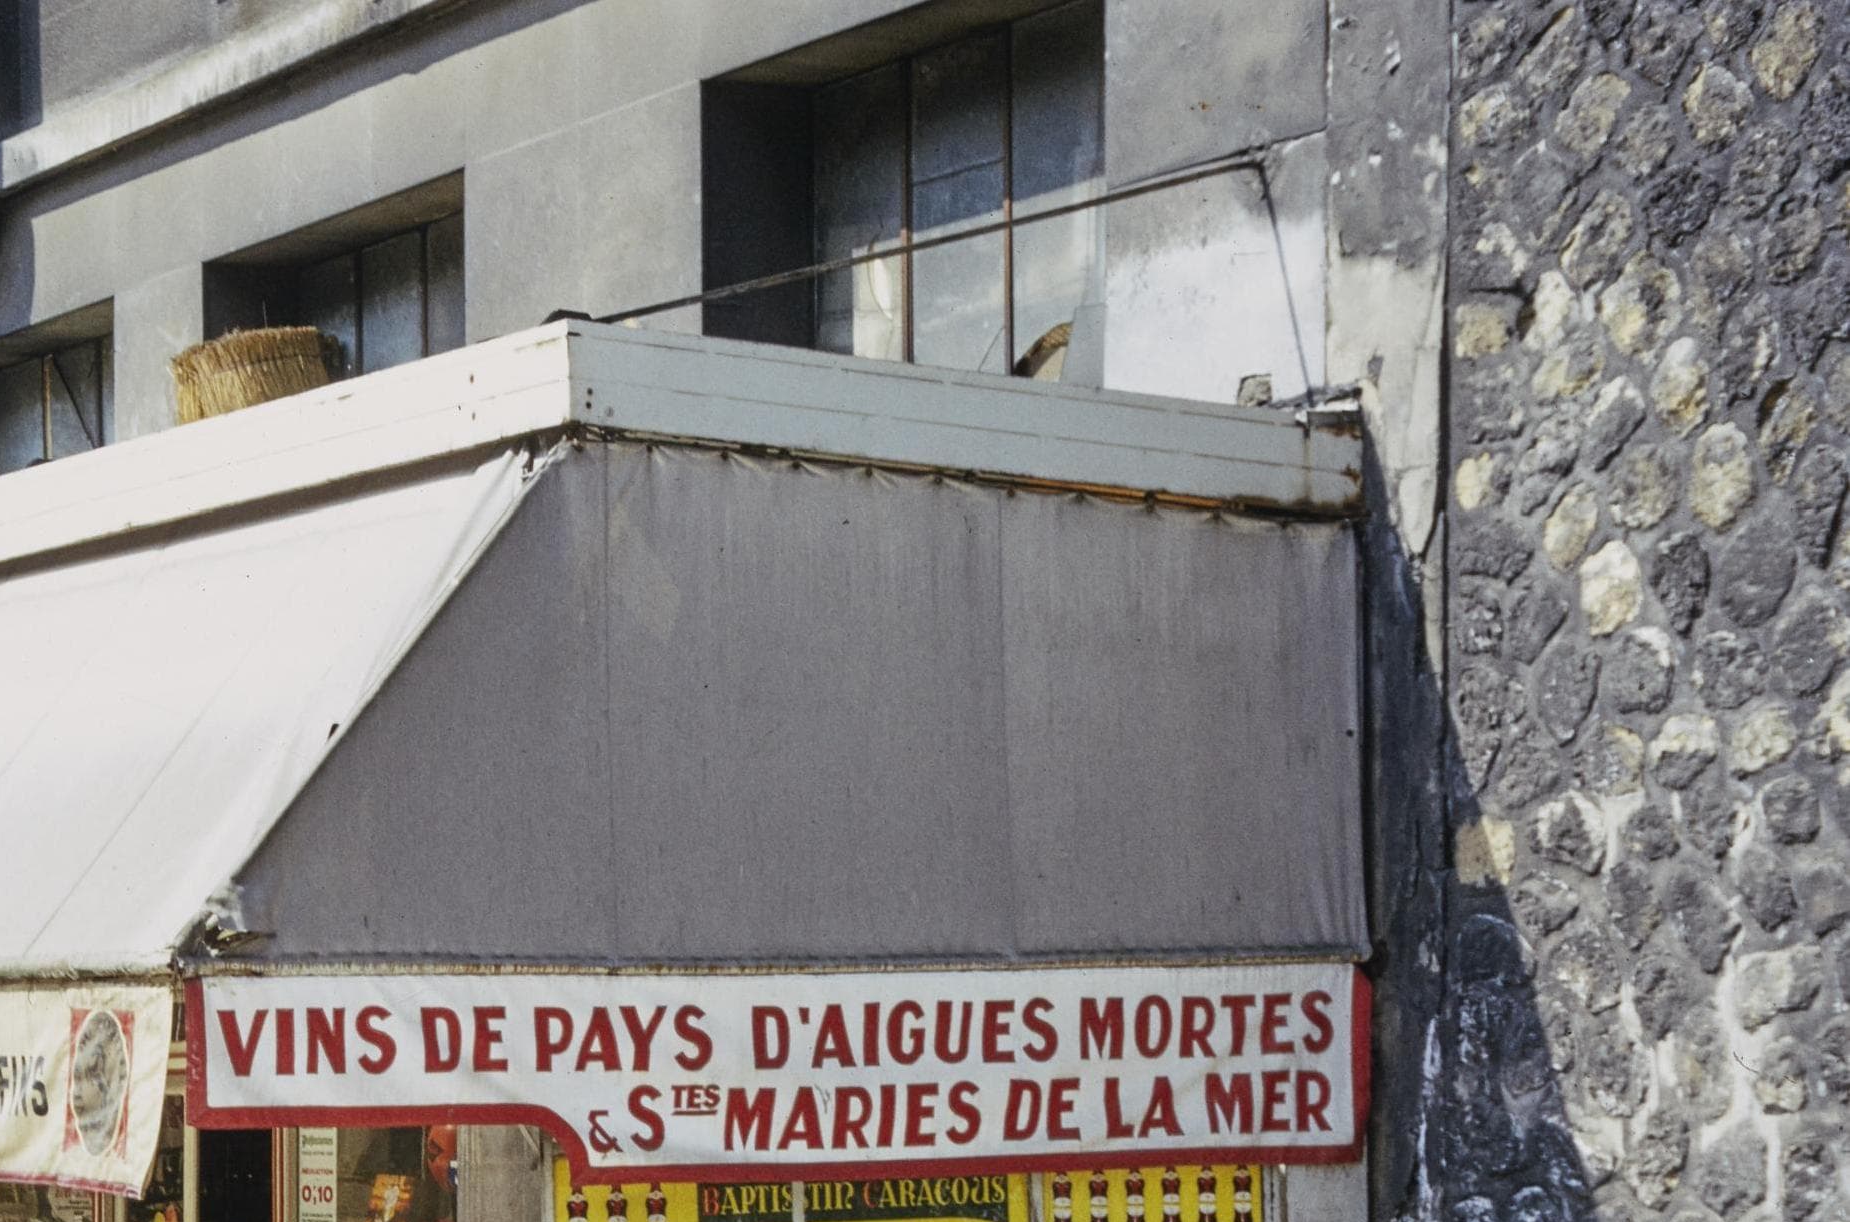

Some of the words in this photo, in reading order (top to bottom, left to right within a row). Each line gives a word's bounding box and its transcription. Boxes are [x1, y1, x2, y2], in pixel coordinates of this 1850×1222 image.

[217, 1005, 397, 1077] VINS
[420, 1005, 509, 1074] DE
[534, 1004, 713, 1073] PAYS
[752, 997, 1058, 1070] D'AIGUES
[1080, 990, 1334, 1061] MORTES
[588, 1109, 624, 1153] &
[724, 1080, 981, 1151] MARIES
[1003, 1077, 1083, 1142] DE
[1103, 1076, 1184, 1140] LA
[1205, 1070, 1333, 1134] MER
